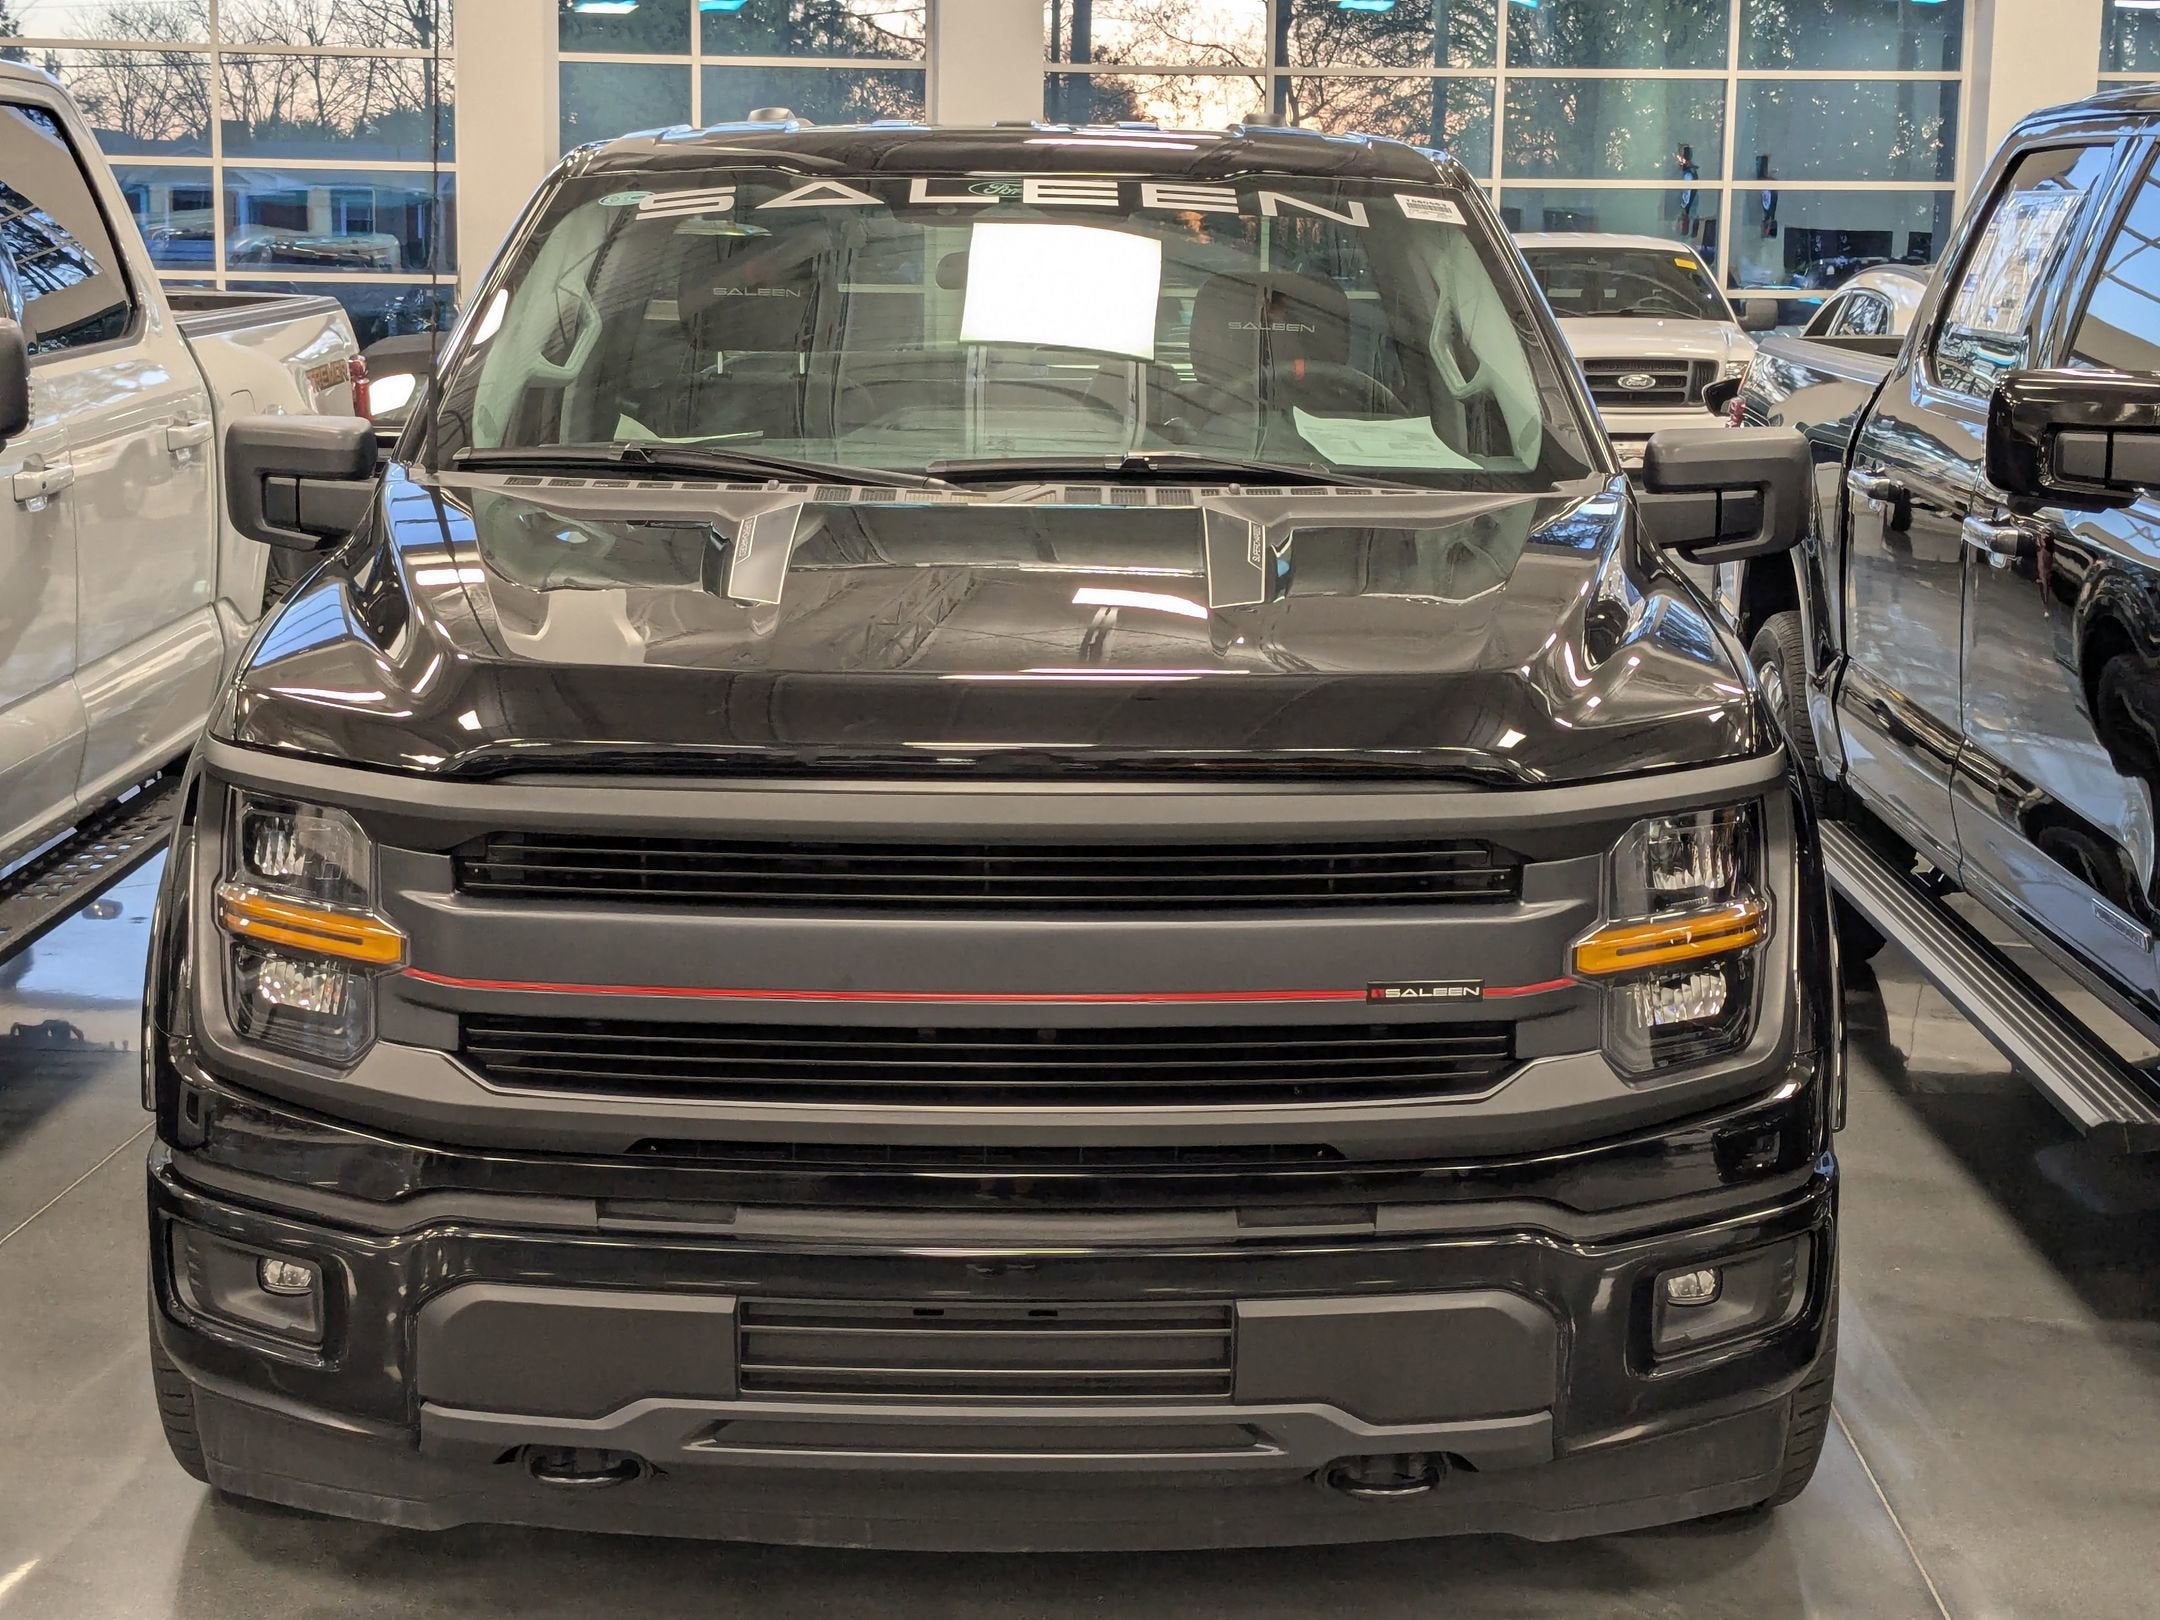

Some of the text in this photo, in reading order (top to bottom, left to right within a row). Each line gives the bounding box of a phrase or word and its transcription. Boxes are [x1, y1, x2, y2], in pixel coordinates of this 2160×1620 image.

[636, 178, 1369, 227] SALEEN
[713, 287, 801, 298] SALEEN
[1228, 321, 1315, 333] SALEEN
[1385, 987, 1480, 998] SALEEN
